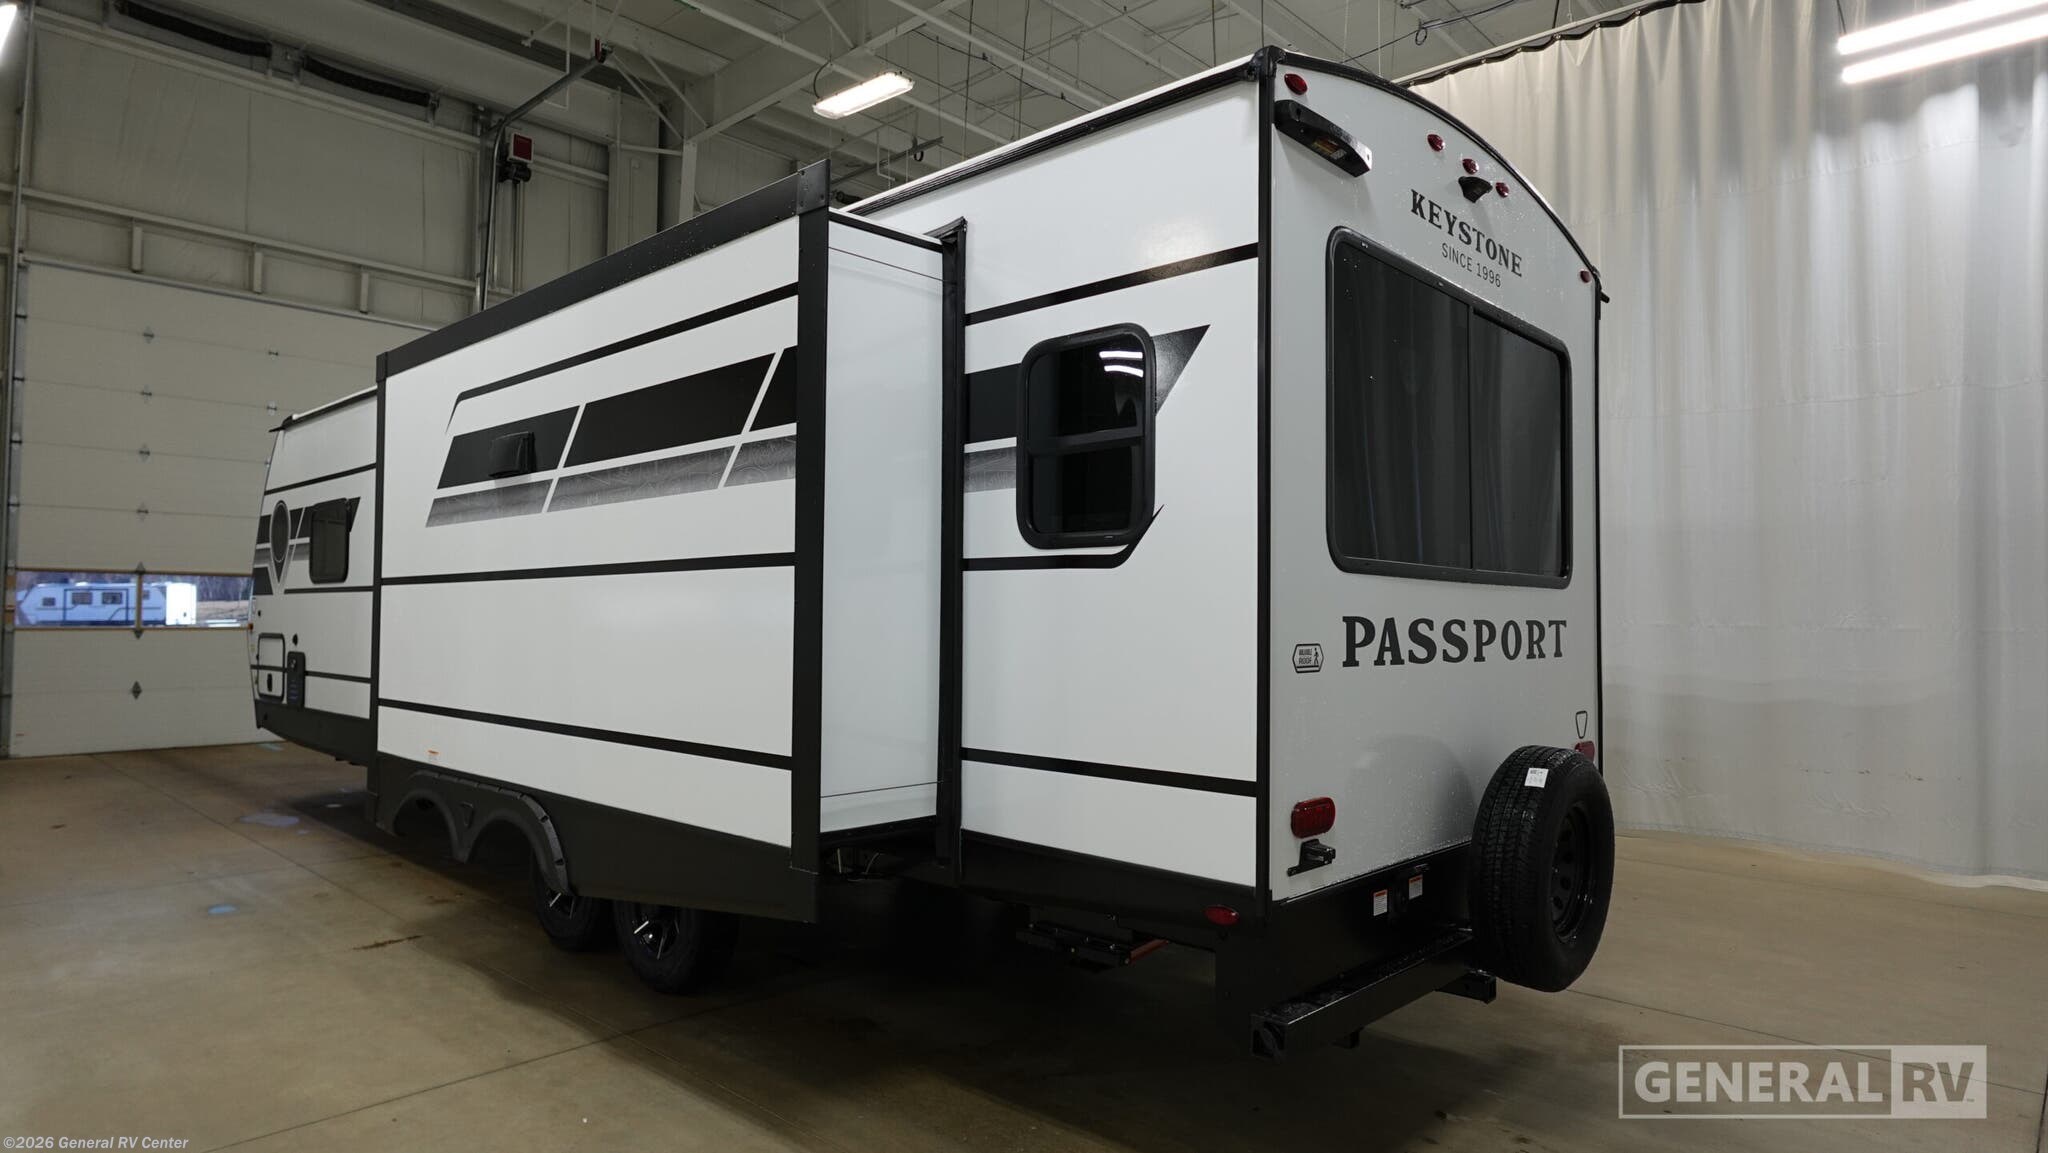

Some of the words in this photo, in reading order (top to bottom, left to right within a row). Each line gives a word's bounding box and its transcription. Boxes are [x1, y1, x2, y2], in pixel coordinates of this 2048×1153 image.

[1411, 189, 1522, 278] KEYSTONE
[1441, 243, 1472, 272] SINCE
[1477, 263, 1501, 287] 1996
[1342, 615, 1567, 668] PASSPORT
